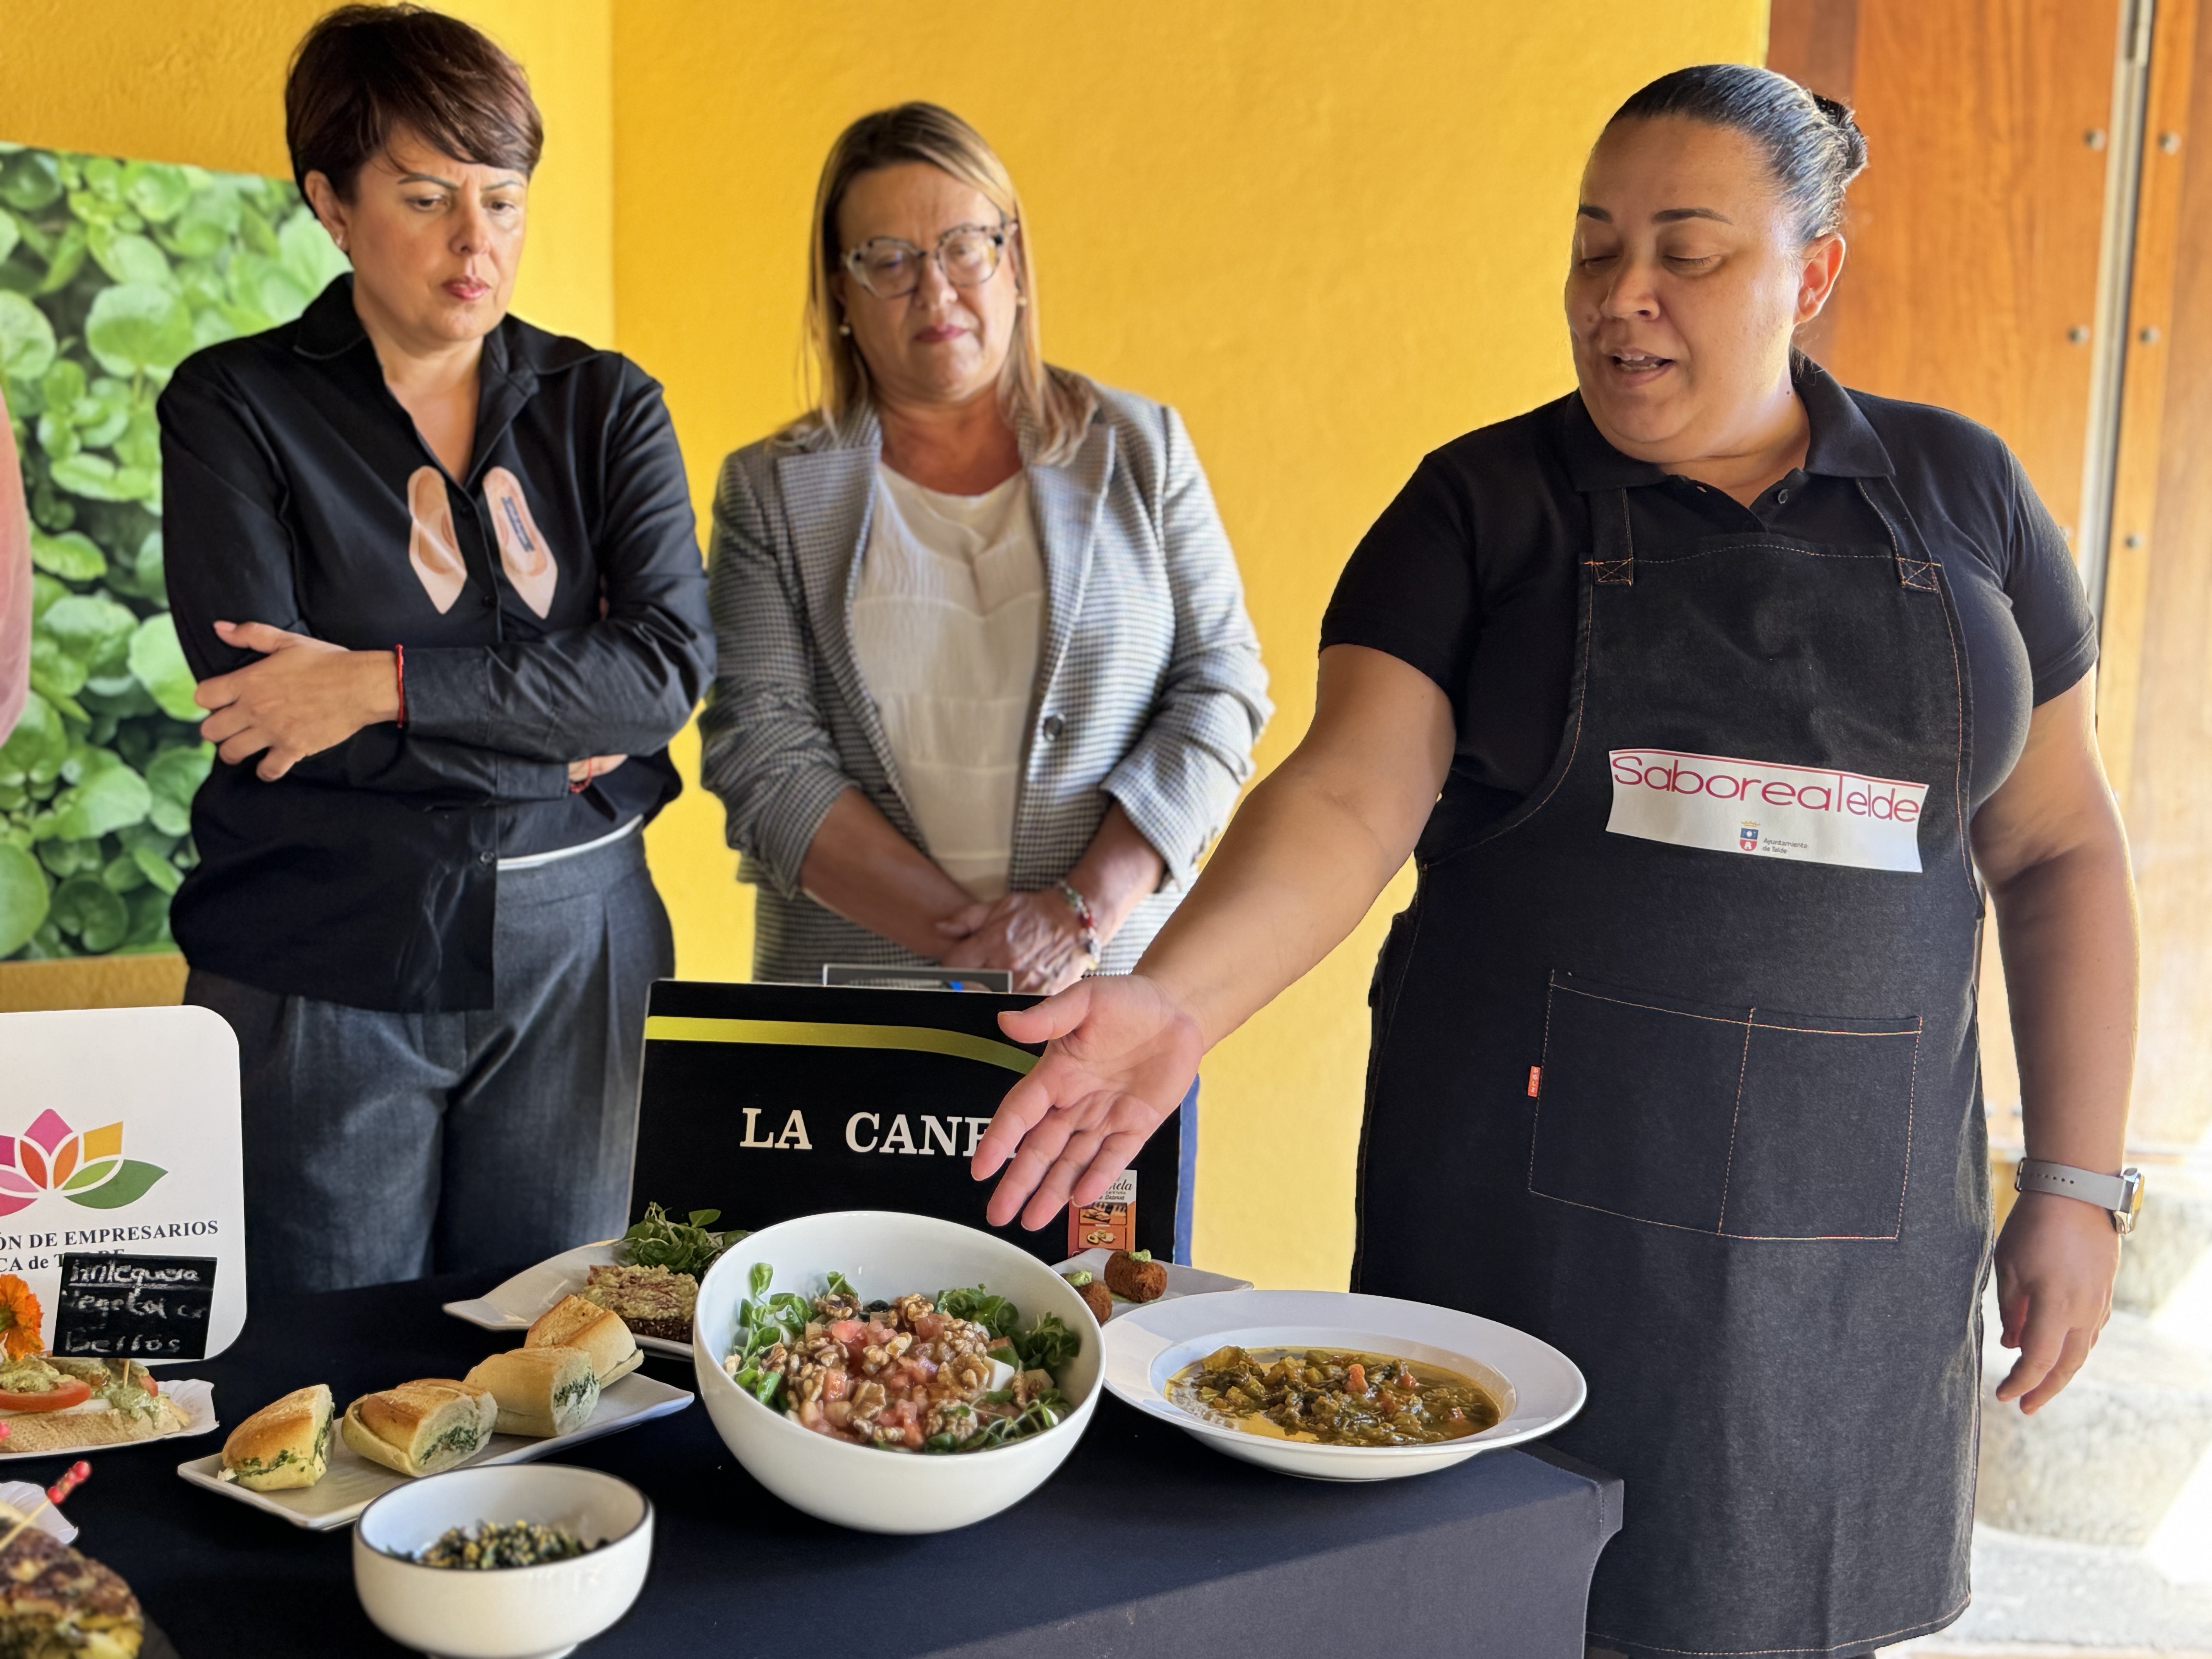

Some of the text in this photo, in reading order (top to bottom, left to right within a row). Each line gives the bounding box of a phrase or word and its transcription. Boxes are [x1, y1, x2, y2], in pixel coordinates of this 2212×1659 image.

[1612, 756, 1920, 823] SaboreaTelde
[1763, 838, 1808, 848] Ayuntamiento
[740, 1108, 1017, 1158] LA CANE
[29, 1233, 57, 1248] DE
[65, 1220, 218, 1246] EMPRESARIOS
[28, 1255, 49, 1270] de
